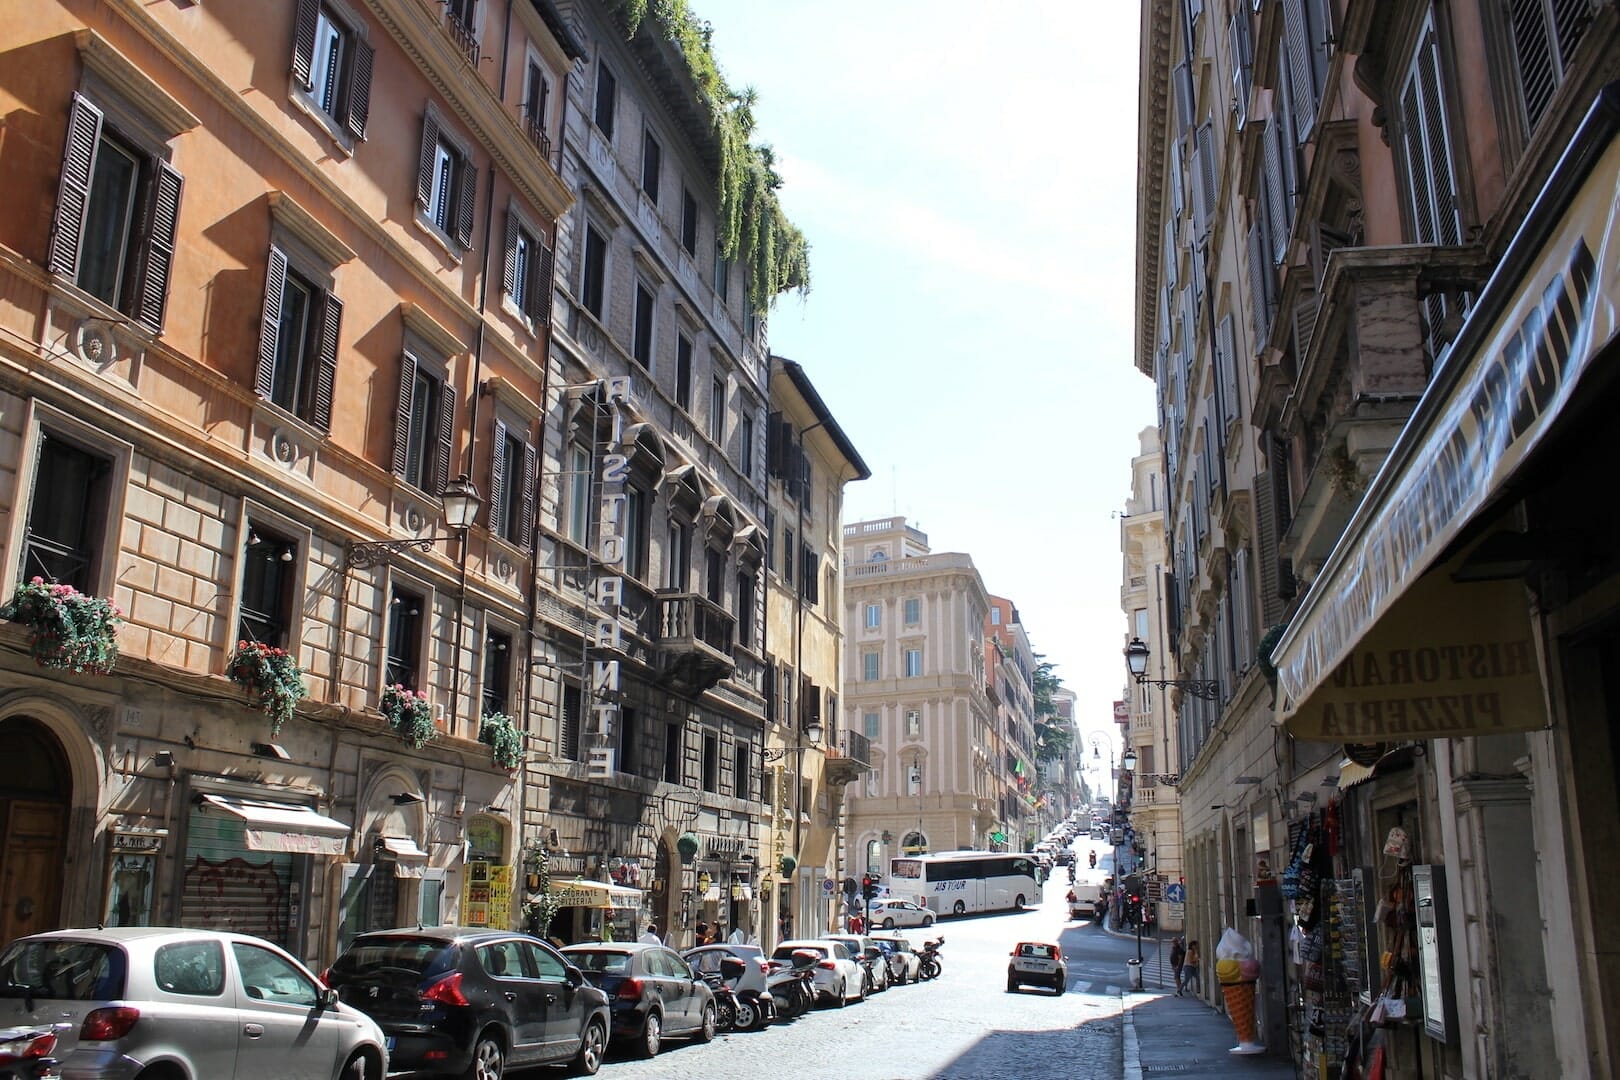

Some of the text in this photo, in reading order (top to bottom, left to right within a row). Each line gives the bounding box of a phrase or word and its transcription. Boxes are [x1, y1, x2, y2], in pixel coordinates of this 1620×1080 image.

[1470, 234, 1597, 477] FREDDA
[775, 765, 786, 874] RORANTE
[549, 856, 585, 872] RISTORANTE
[934, 880, 967, 892] AIS TOUR
[556, 889, 598, 898] STORANTE
[561, 897, 592, 906] PIZZERIA
